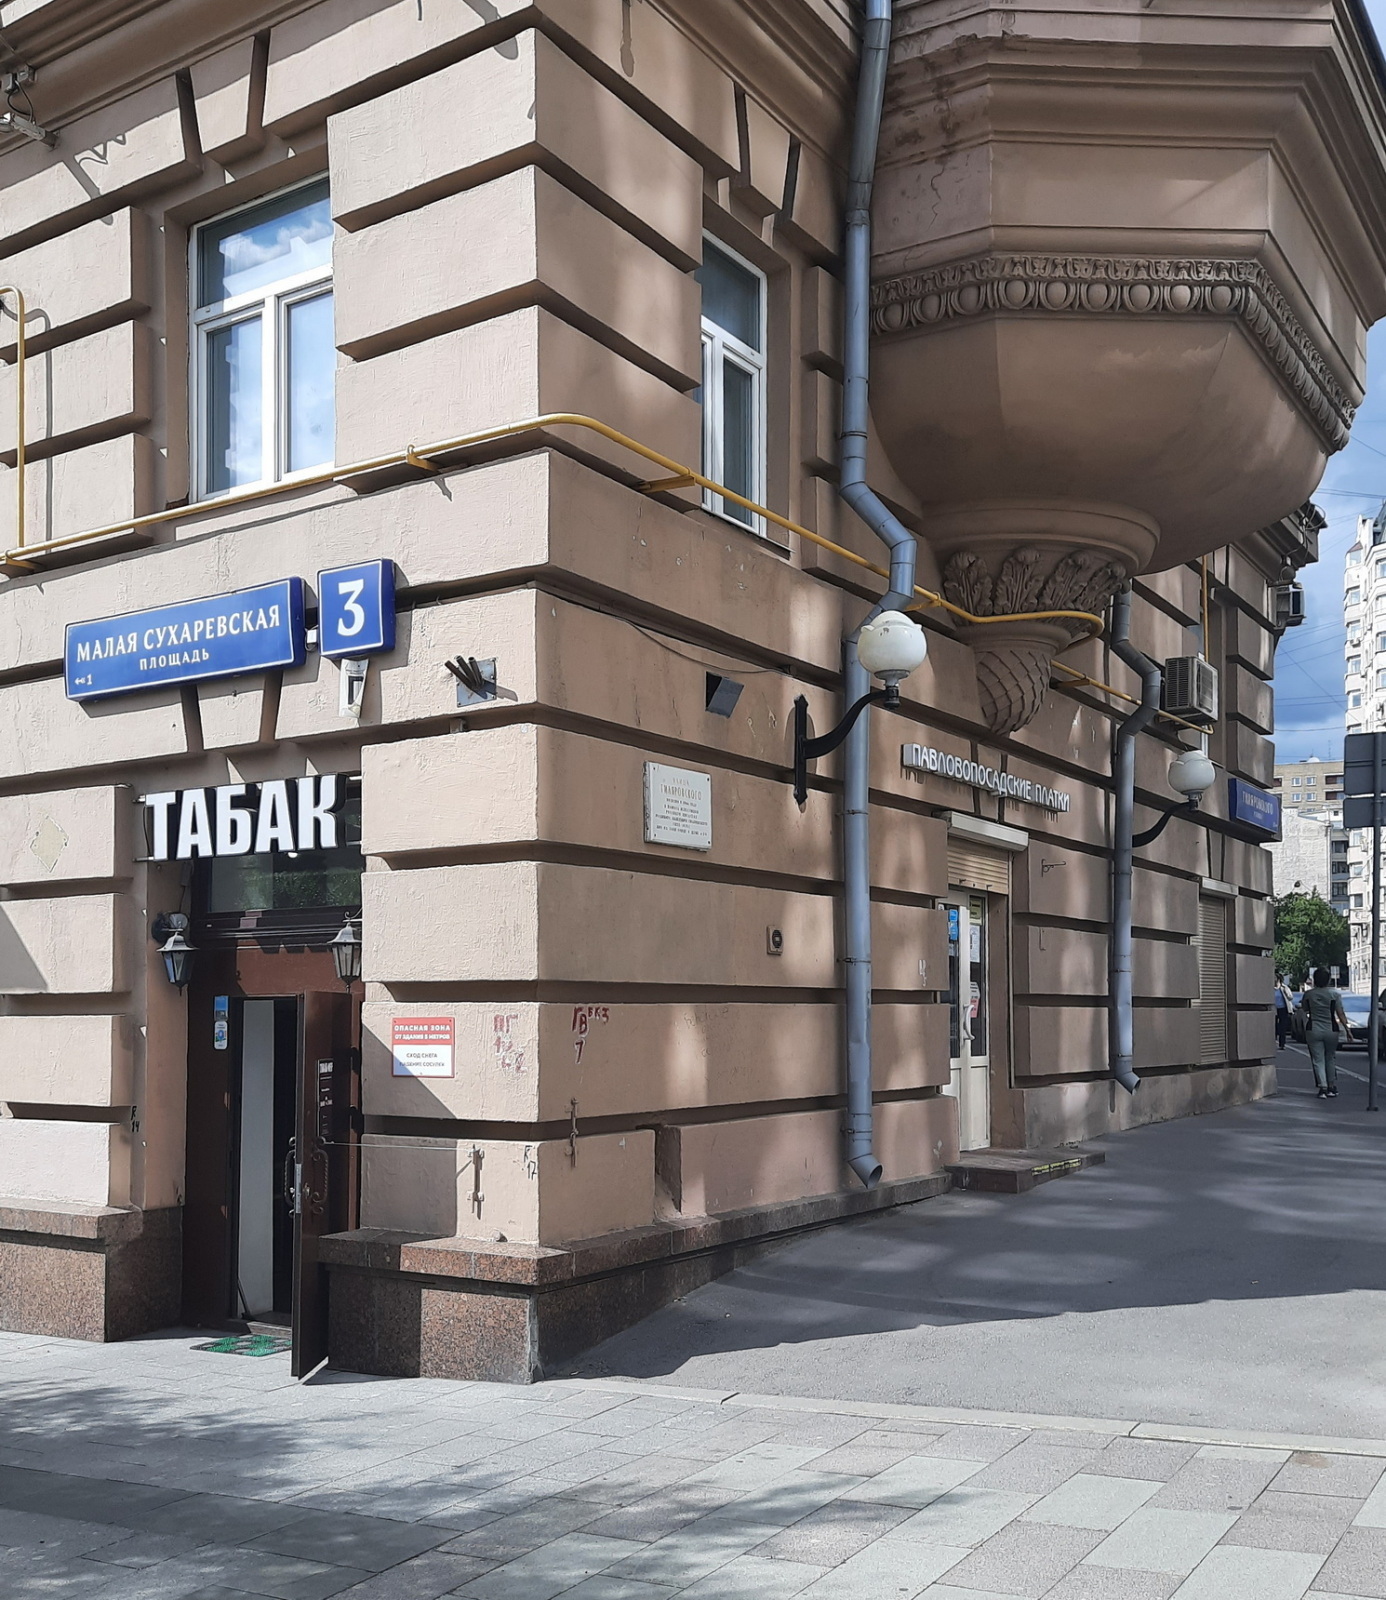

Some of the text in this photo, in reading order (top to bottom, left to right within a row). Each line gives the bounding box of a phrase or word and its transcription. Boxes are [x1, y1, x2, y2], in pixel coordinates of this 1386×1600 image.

[77, 604, 280, 663] МАЛАЯ СУХАРЕВСКАЯ
[337, 578, 366, 637] 3
[86, 674, 93, 685] 1
[139, 648, 210, 671] ПЛОЩАДЬ
[912, 743, 1070, 812] ПАВЛОВОПОСАДСКИЕ ПЛАТКИ
[145, 774, 337, 862] ТАБАК
